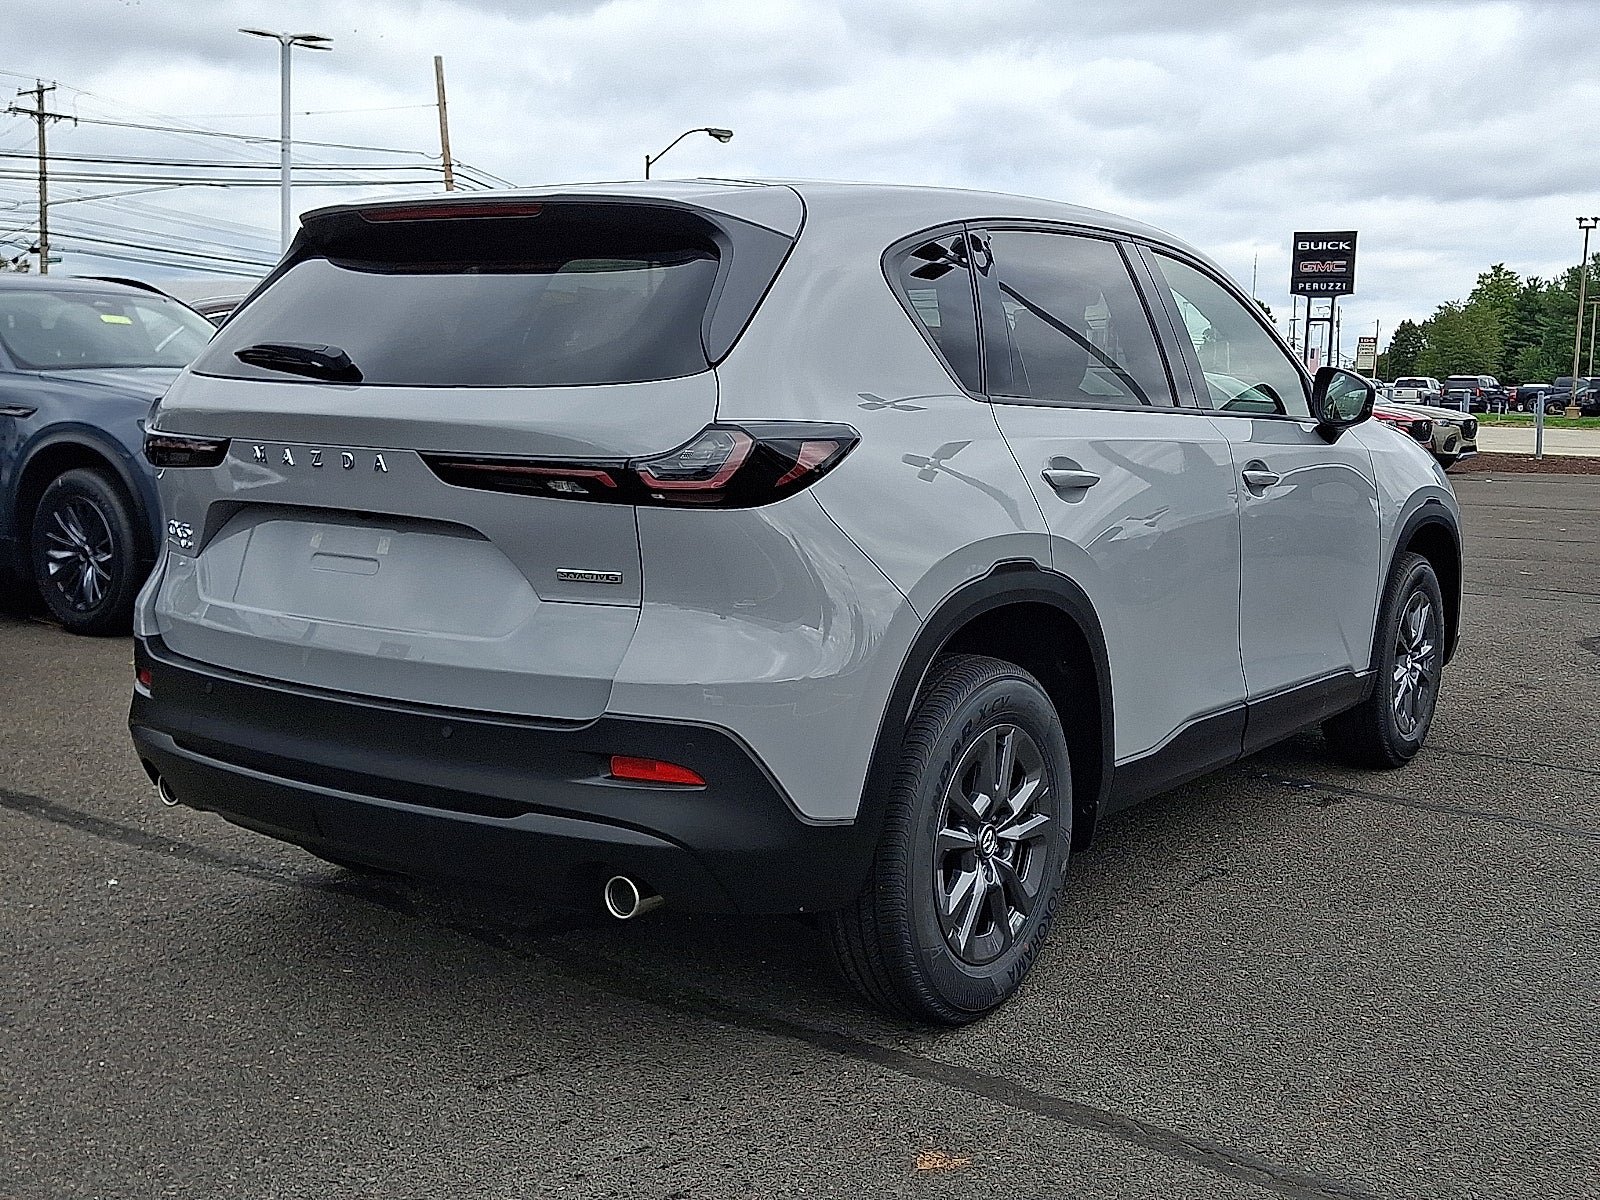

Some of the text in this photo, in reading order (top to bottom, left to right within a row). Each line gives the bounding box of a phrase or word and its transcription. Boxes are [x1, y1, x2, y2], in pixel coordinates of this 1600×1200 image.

[1297, 240, 1351, 250] BUICK
[1300, 260, 1347, 273] GMC
[1298, 282, 1346, 291] PERUZZI
[253, 445, 389, 473] MAZDA
[1007, 886, 1062, 985] YOKOHAMA
